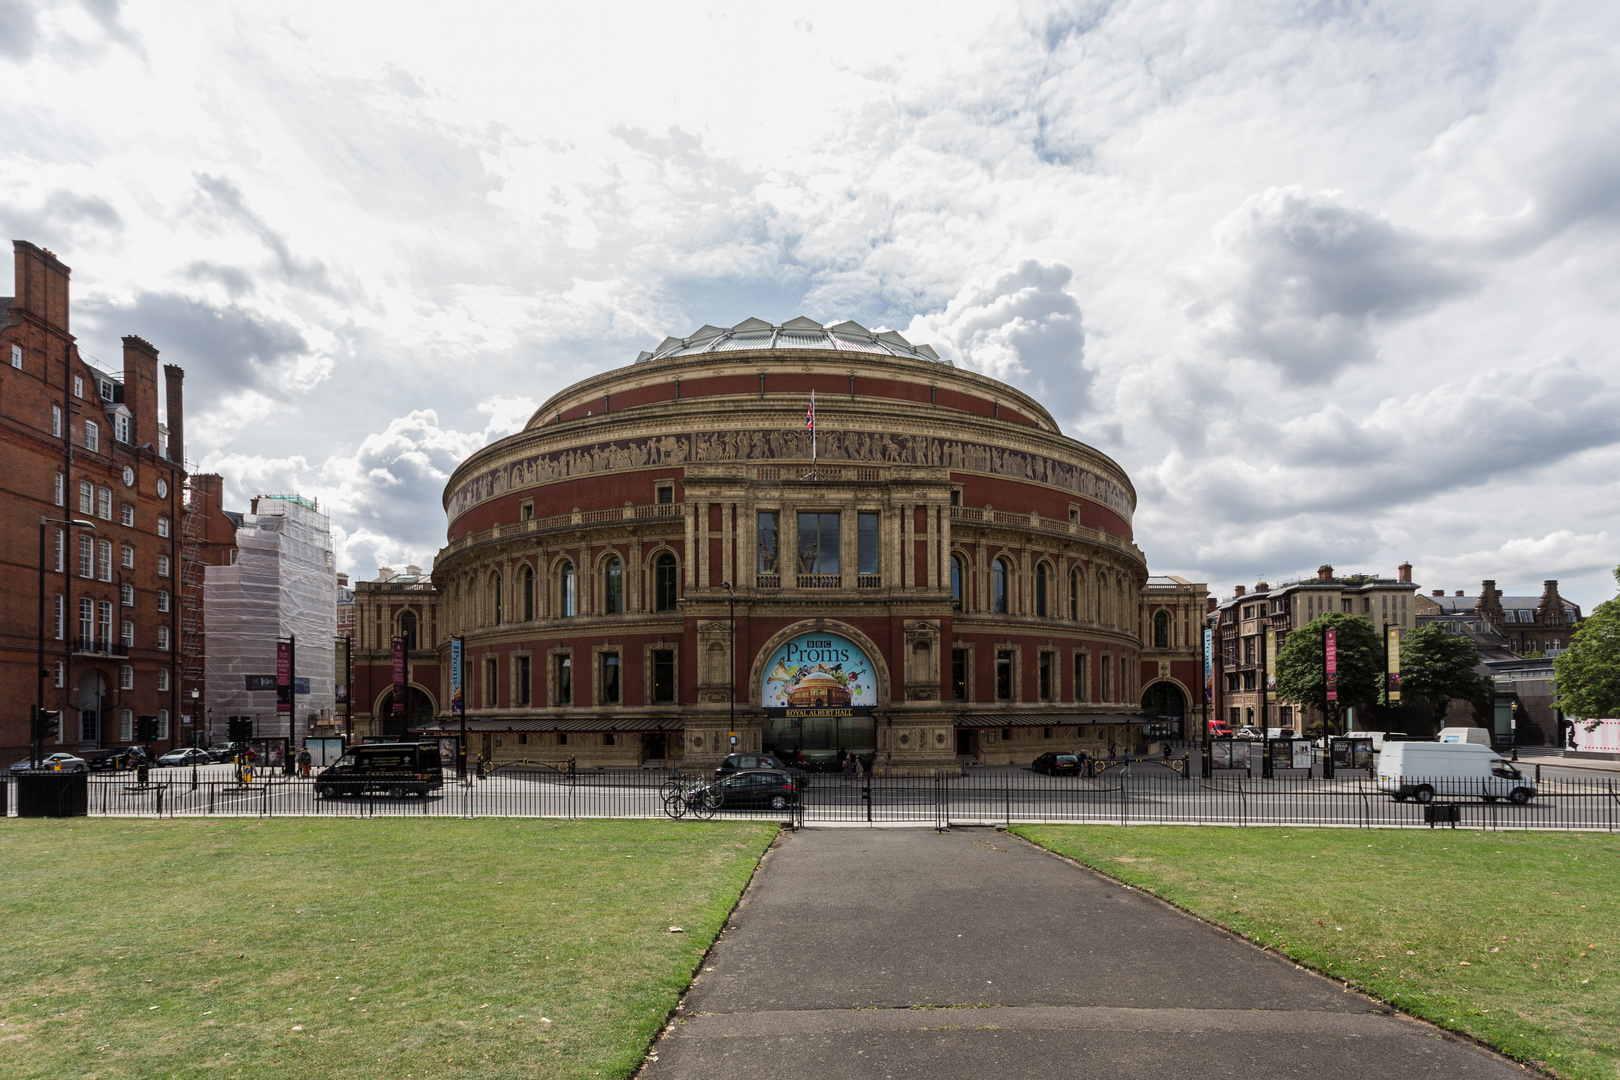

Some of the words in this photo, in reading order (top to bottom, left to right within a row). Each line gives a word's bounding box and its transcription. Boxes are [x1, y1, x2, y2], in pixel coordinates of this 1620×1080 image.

[785, 643, 849, 662] Proms
[787, 709, 808, 717] ROYAL
[836, 708, 853, 716] HALL
